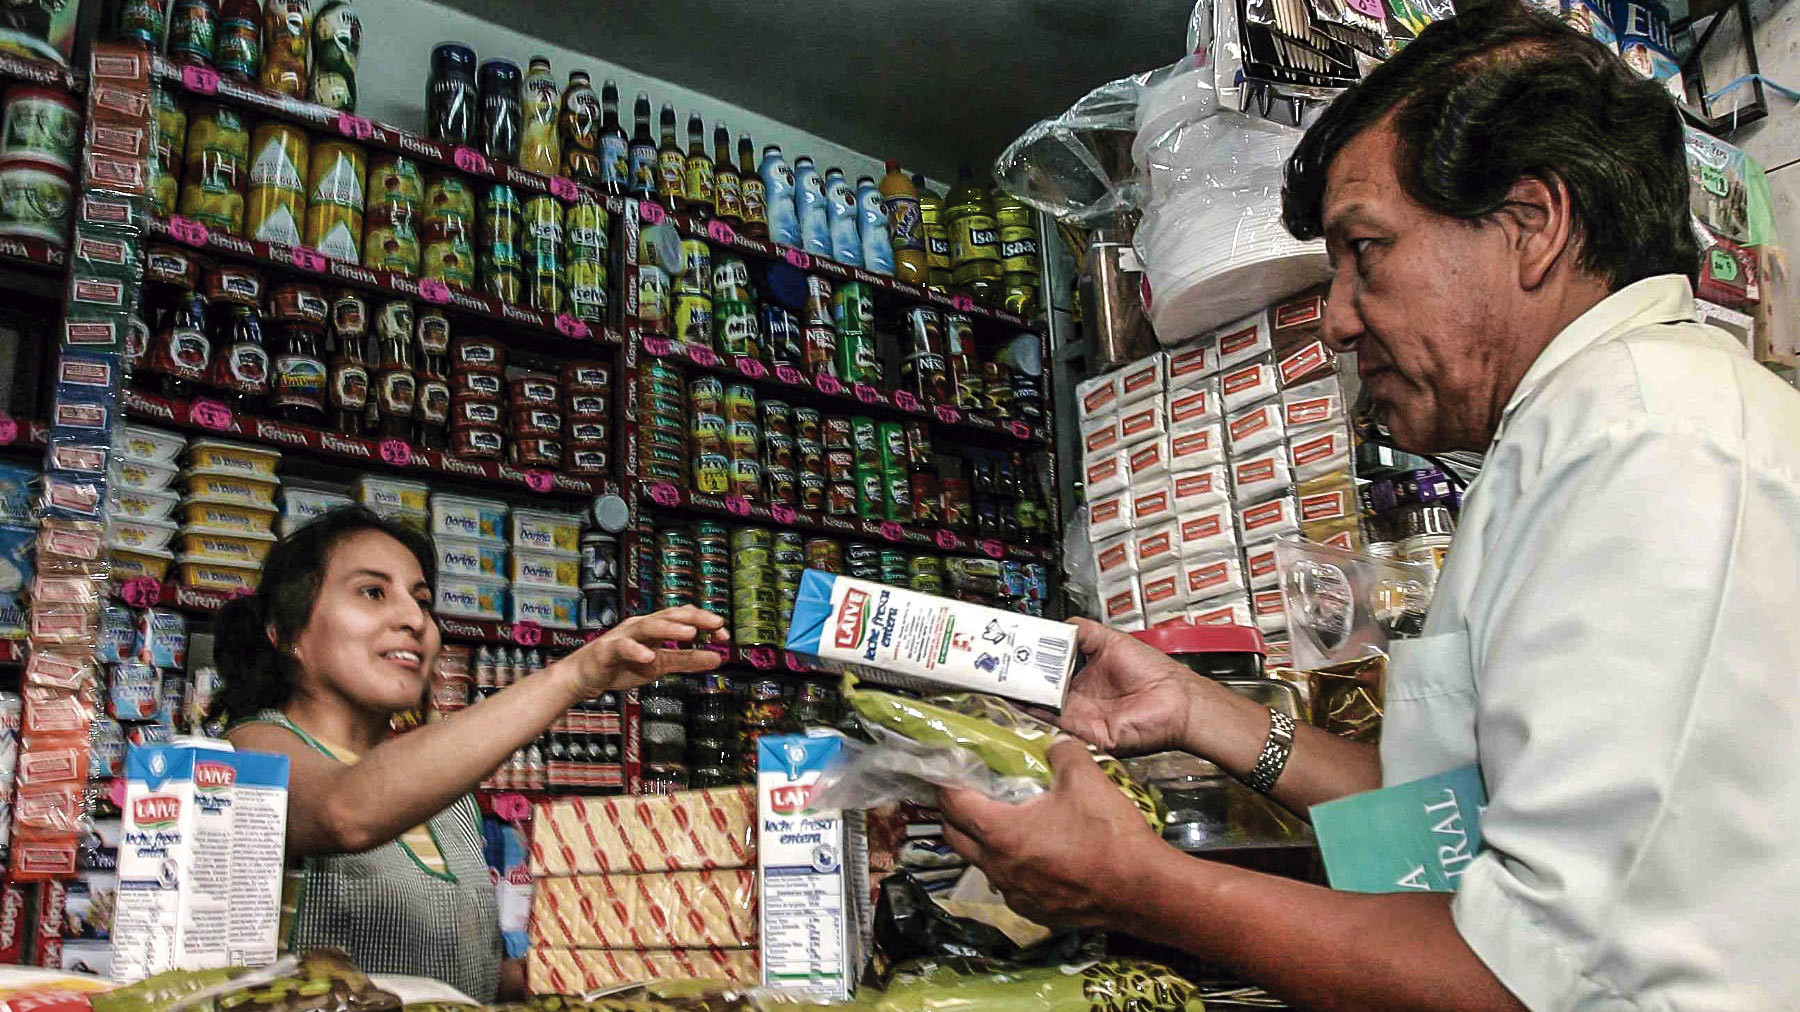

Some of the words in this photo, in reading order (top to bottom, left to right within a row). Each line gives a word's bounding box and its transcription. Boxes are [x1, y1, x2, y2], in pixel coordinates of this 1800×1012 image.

[838, 589, 864, 646] LAIVE
[197, 766, 233, 785] LAIVE
[135, 799, 180, 818] LAIVE
[780, 832, 821, 844] entera
